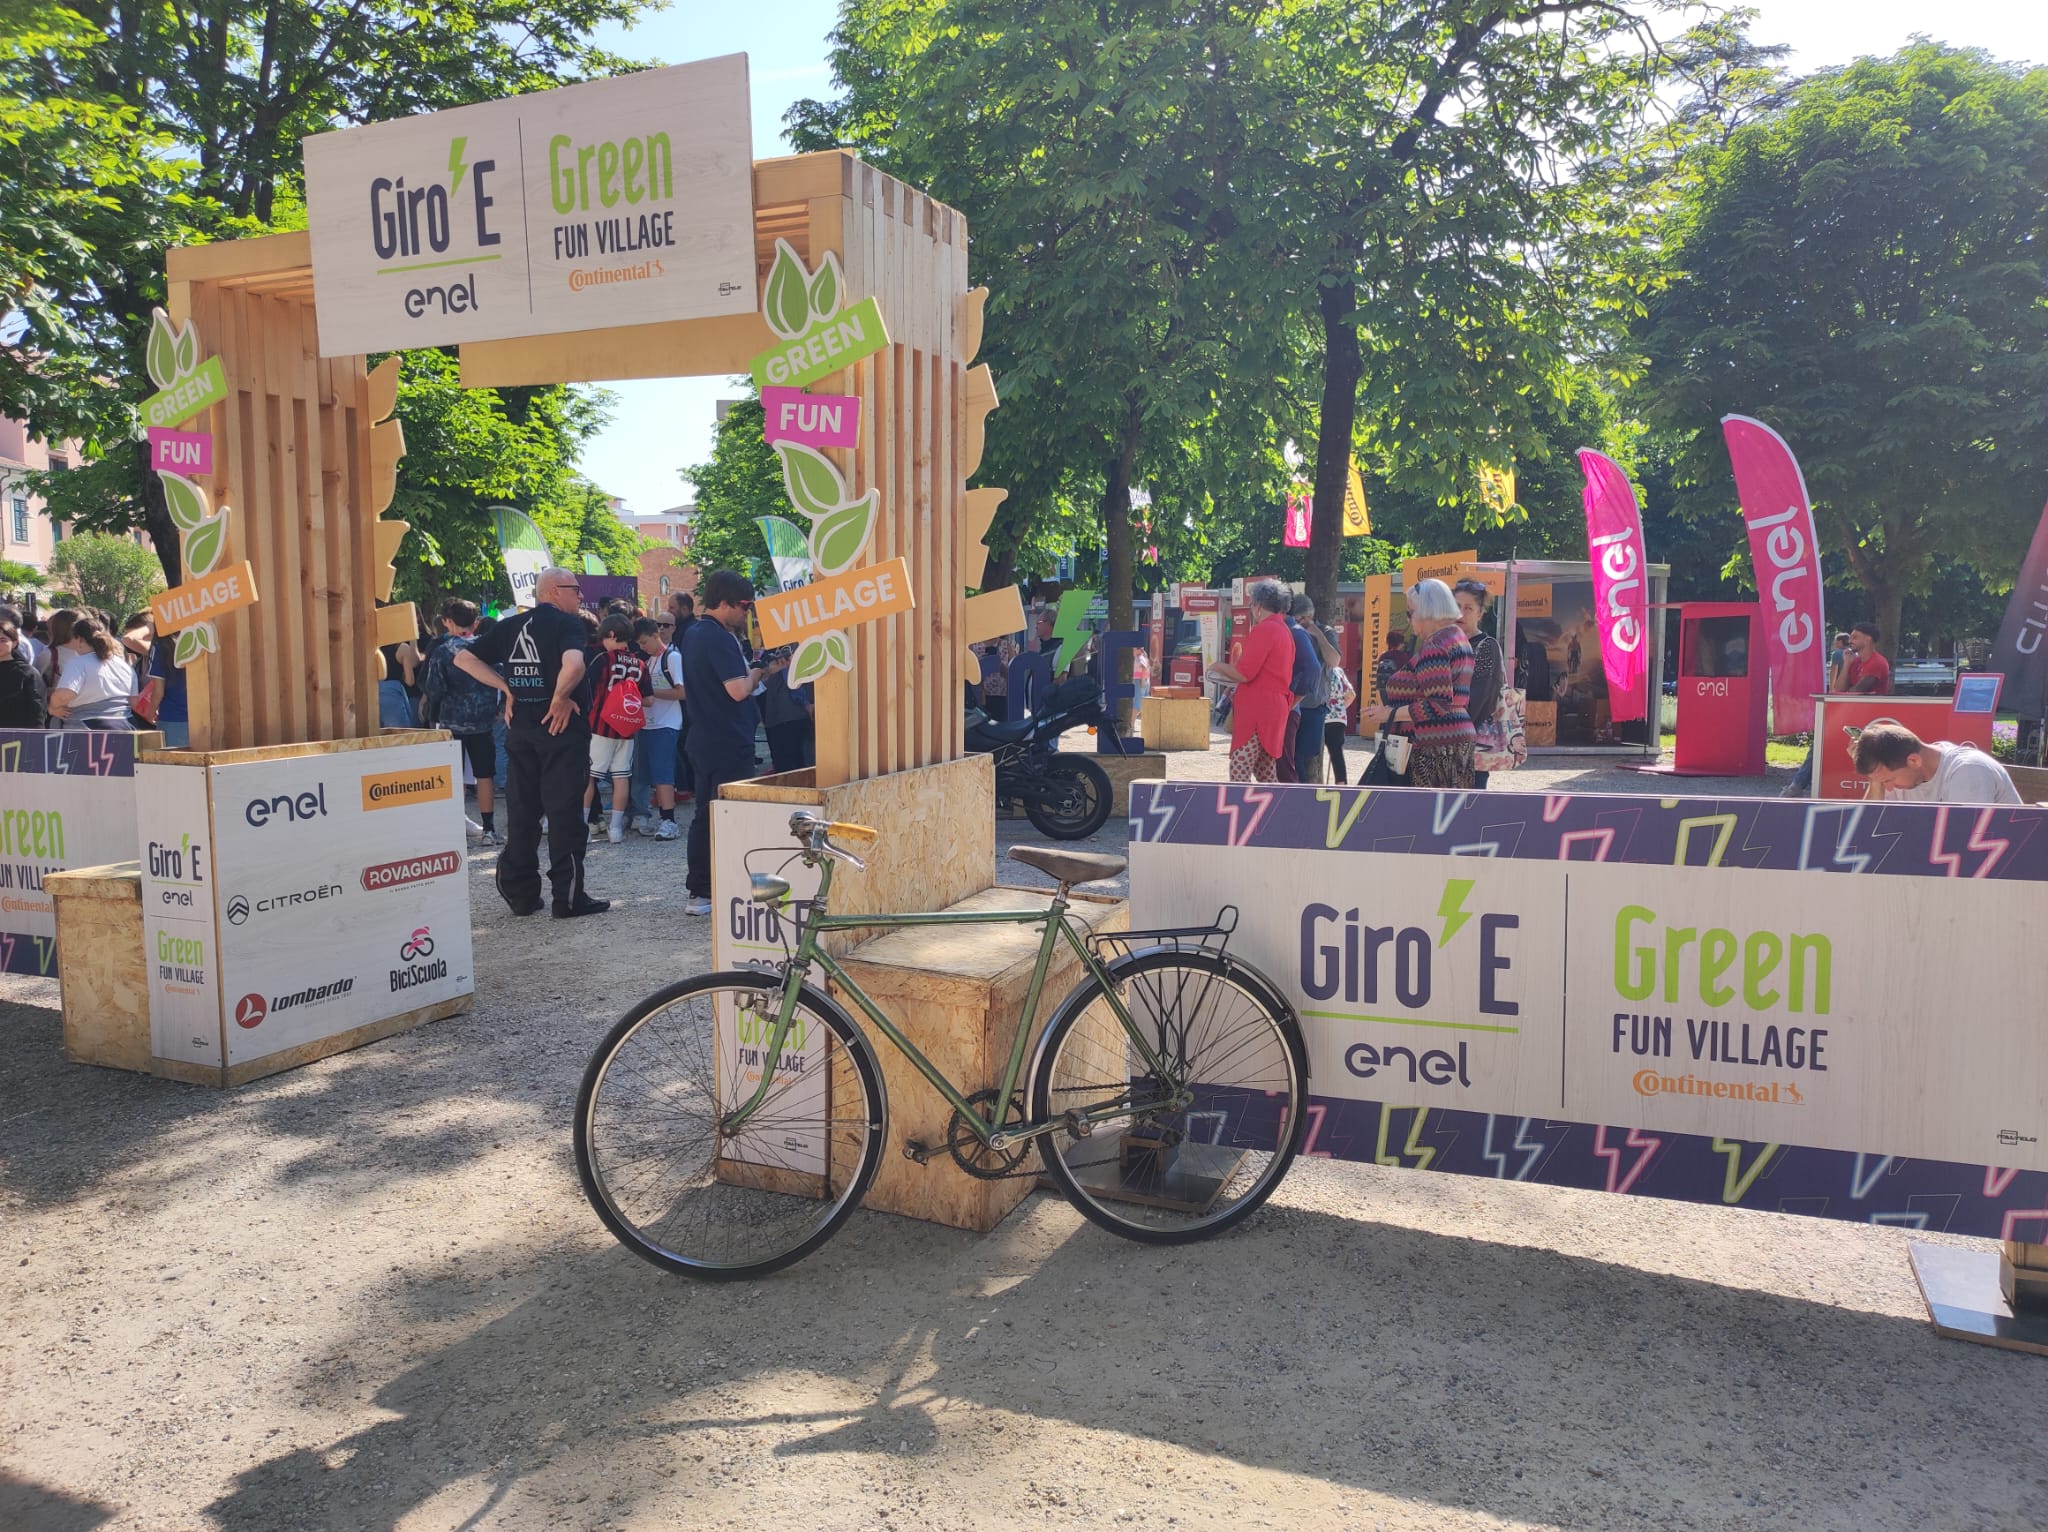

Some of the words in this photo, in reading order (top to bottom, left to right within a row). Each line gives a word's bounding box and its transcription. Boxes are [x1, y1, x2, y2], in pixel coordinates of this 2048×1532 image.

[549, 131, 673, 215] Green
[554, 224, 589, 260] FUN
[594, 211, 675, 255] VILLAGE
[568, 261, 651, 292] Continental
[405, 273, 478, 318] enel
[765, 315, 865, 384] GREEN
[150, 371, 213, 425] GREEN
[780, 403, 841, 433] FUN
[159, 440, 201, 465] FUN
[1417, 564, 1453, 581] Continental
[1592, 526, 1641, 653] enel
[1748, 505, 1814, 654] enel
[158, 575, 240, 624] VILLAGE
[769, 573, 896, 633] VILLAGE
[513, 666, 540, 676] DELTA
[1369, 612, 1380, 708] ontinental
[508, 678, 545, 688] SERVICE
[1697, 677, 1729, 697] enel
[246, 783, 327, 826] enel
[369, 776, 435, 801] Continental
[0, 809, 64, 859] reen
[369, 855, 453, 886] ROVAGNATI
[162, 889, 194, 906] enel
[256, 884, 343, 912] CITROËN
[157, 930, 204, 967] Green
[1614, 905, 1832, 1015] Green
[159, 965, 172, 980] FUN
[175, 967, 205, 985] VILLAGE
[390, 958, 447, 993] BiciScuola
[271, 978, 354, 1012] Lombardo
[739, 1048, 758, 1066] FUN
[1613, 1014, 1671, 1058] FUN
[1688, 1018, 1828, 1072] VILLAGE
[1345, 1042, 1471, 1089] enel
[1633, 1069, 1779, 1103] Continental
